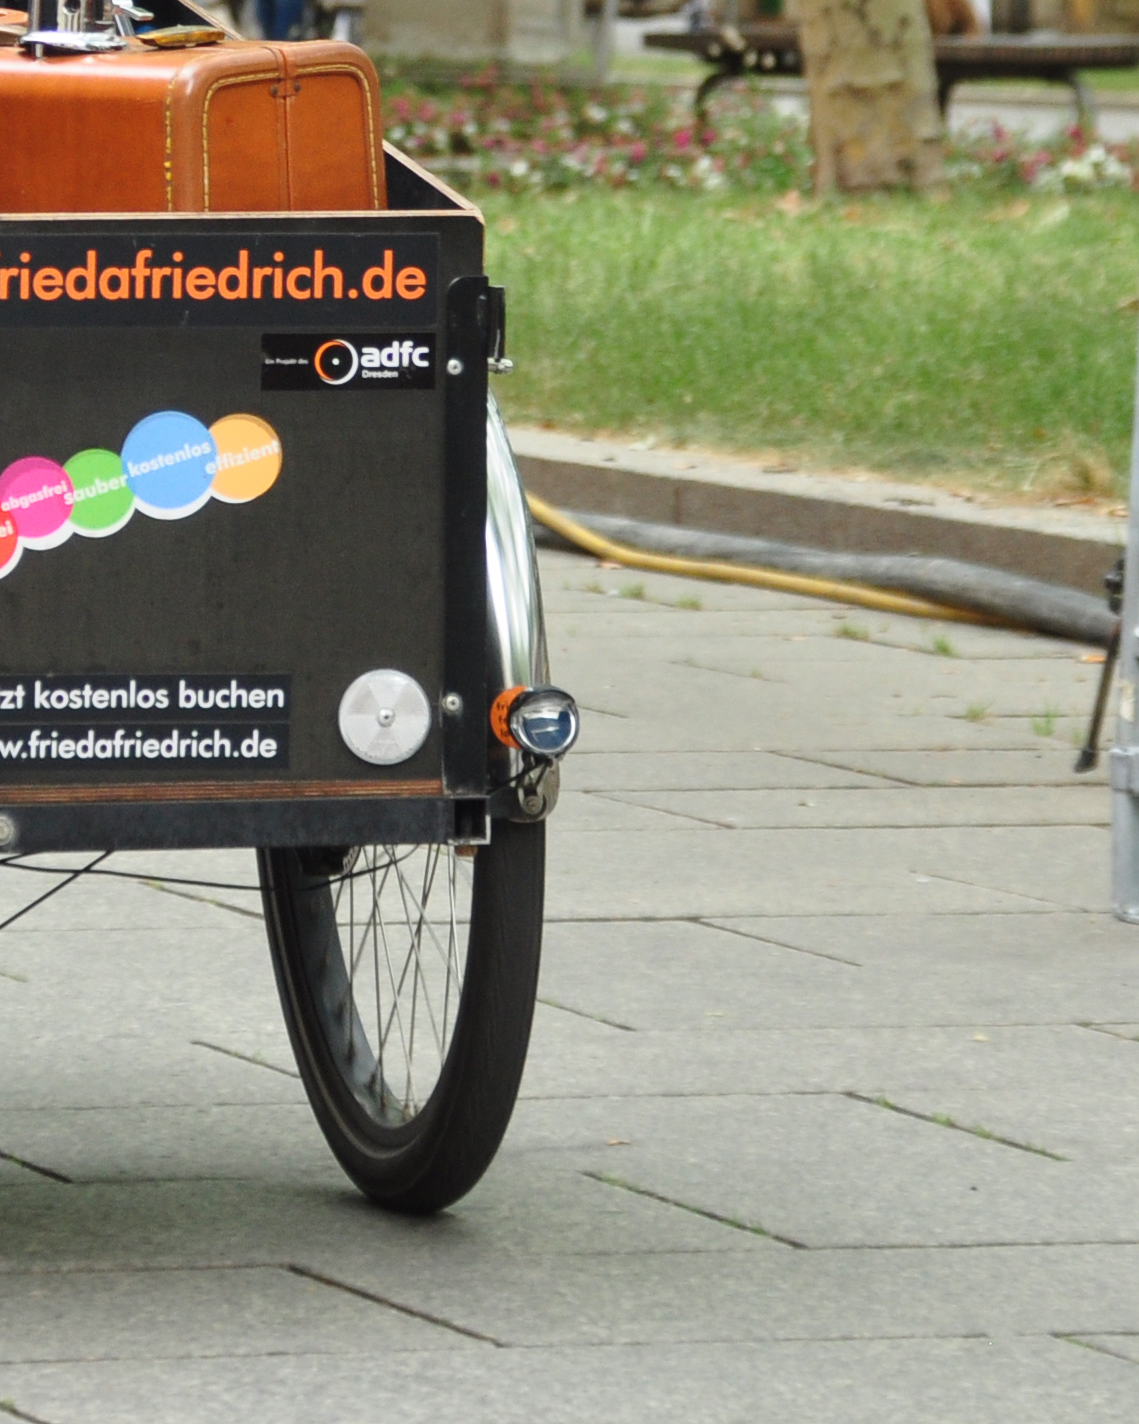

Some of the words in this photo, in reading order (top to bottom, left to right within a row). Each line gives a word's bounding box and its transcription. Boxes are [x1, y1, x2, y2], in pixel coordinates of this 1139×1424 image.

[361, 340, 430, 367] adfc
[361, 370, 399, 378] Dresden
[0, 479, 68, 513] abgasfrei
[63, 473, 128, 506] sauber
[127, 441, 212, 478] kostenlos
[204, 439, 281, 476] effizient
[34, 679, 170, 710] kostenlos
[178, 679, 285, 708] buchen
